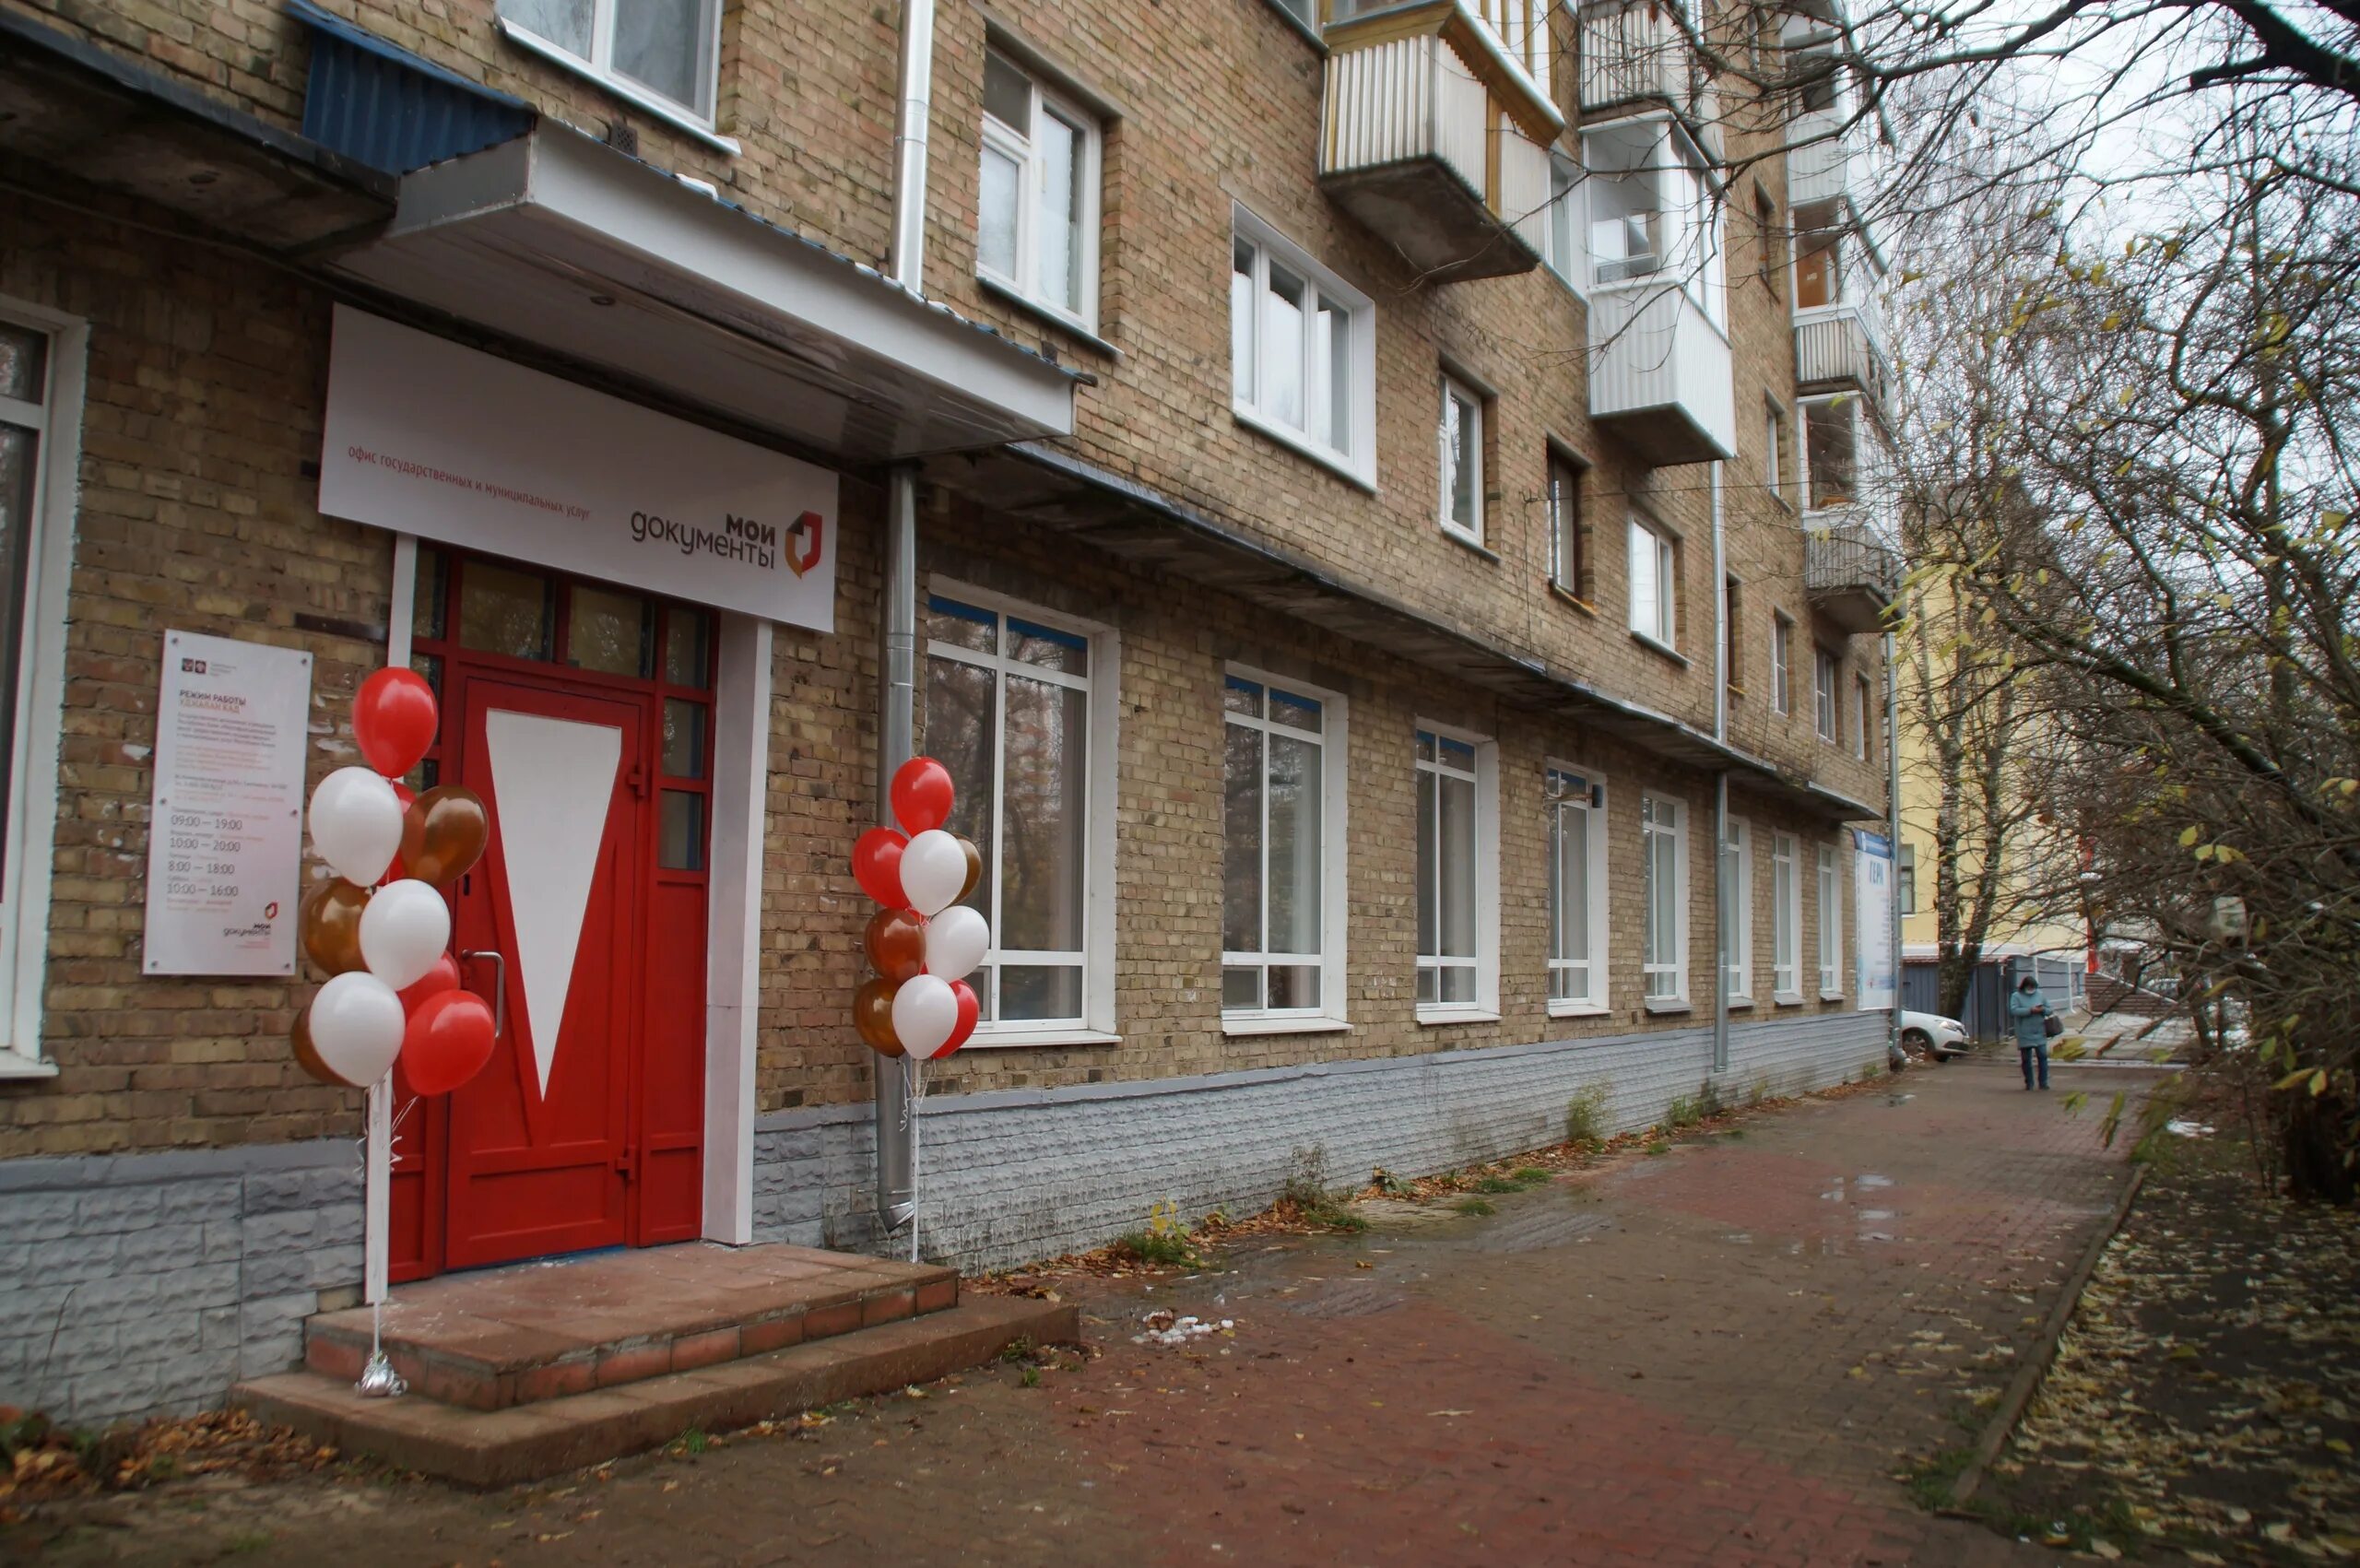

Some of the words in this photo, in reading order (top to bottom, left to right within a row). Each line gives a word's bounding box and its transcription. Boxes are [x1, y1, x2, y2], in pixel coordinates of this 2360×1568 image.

[348, 444, 377, 465] офис
[380, 454, 473, 489] государственных
[475, 480, 483, 492] и
[485, 483, 564, 513] муниципальных
[566, 503, 591, 522] услуг
[725, 513, 775, 547] мои
[631, 510, 775, 570] документы
[180, 690, 211, 701] РЕЖИМ
[213, 694, 246, 706] РАБОТЫ
[171, 814, 201, 827] 09:00
[215, 818, 243, 831] 19:00
[170, 837, 199, 849] 10:00
[213, 840, 242, 852] 20:00
[168, 860, 191, 872] 8:00
[206, 863, 236, 875] 18:00
[167, 882, 196, 894] 10:00
[210, 885, 239, 897] 16:00
